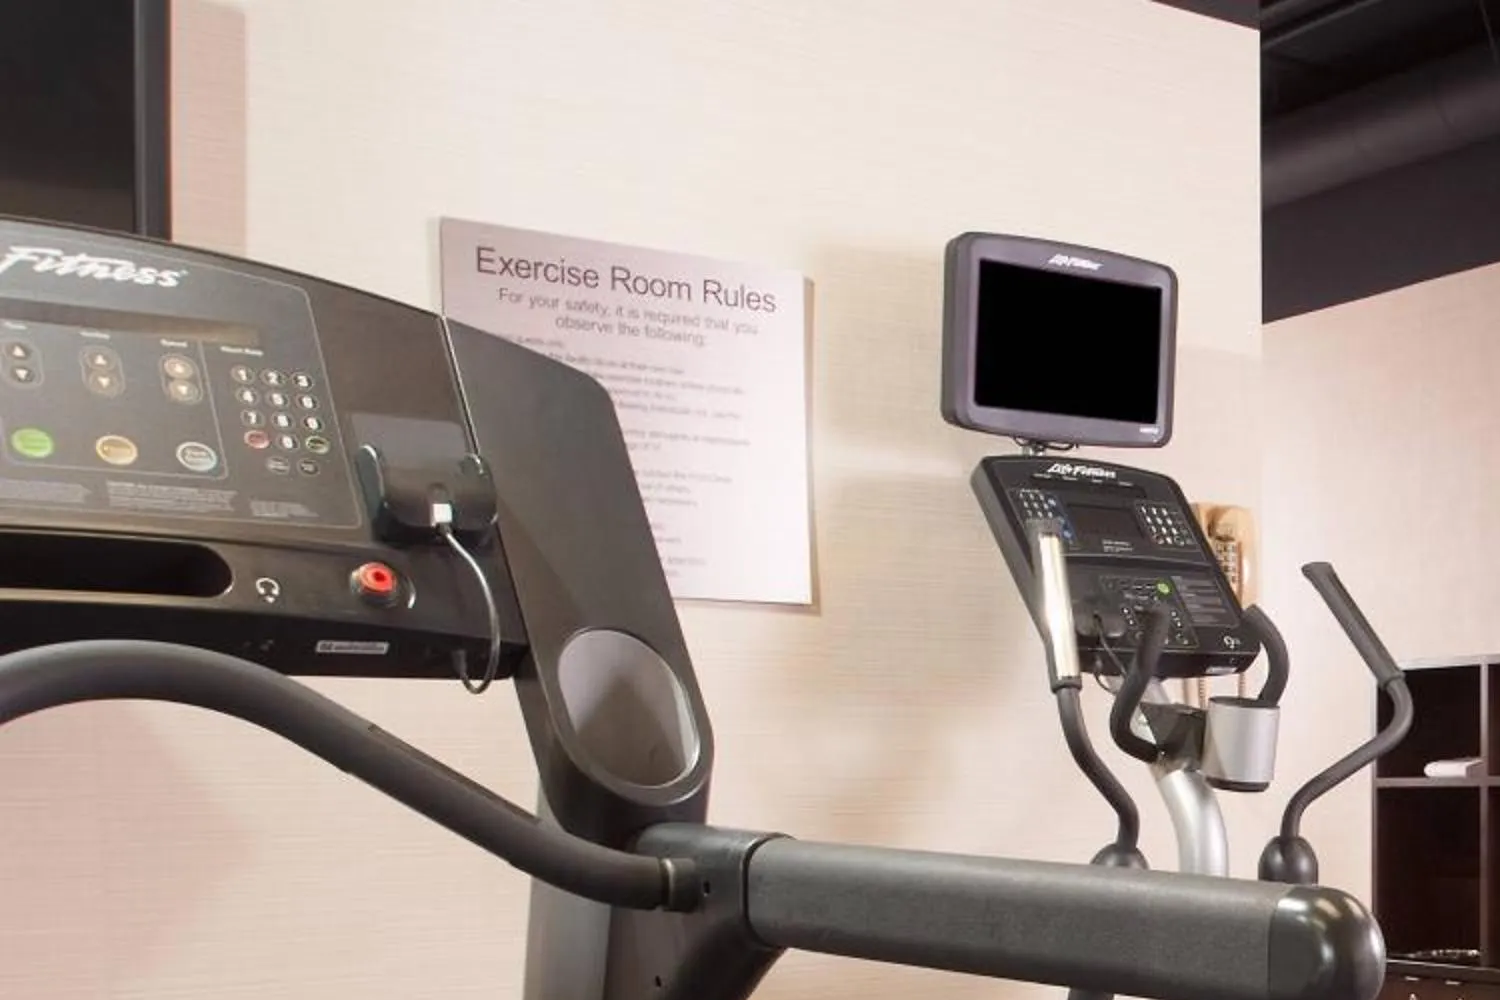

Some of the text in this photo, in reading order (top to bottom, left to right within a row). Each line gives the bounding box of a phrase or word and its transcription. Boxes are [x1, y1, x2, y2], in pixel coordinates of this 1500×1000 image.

[475, 245, 777, 313] Exercise Room Rules
[497, 287, 759, 336] For your safety, it is required that you
[554, 314, 615, 335] observe
[617, 322, 641, 338] the
